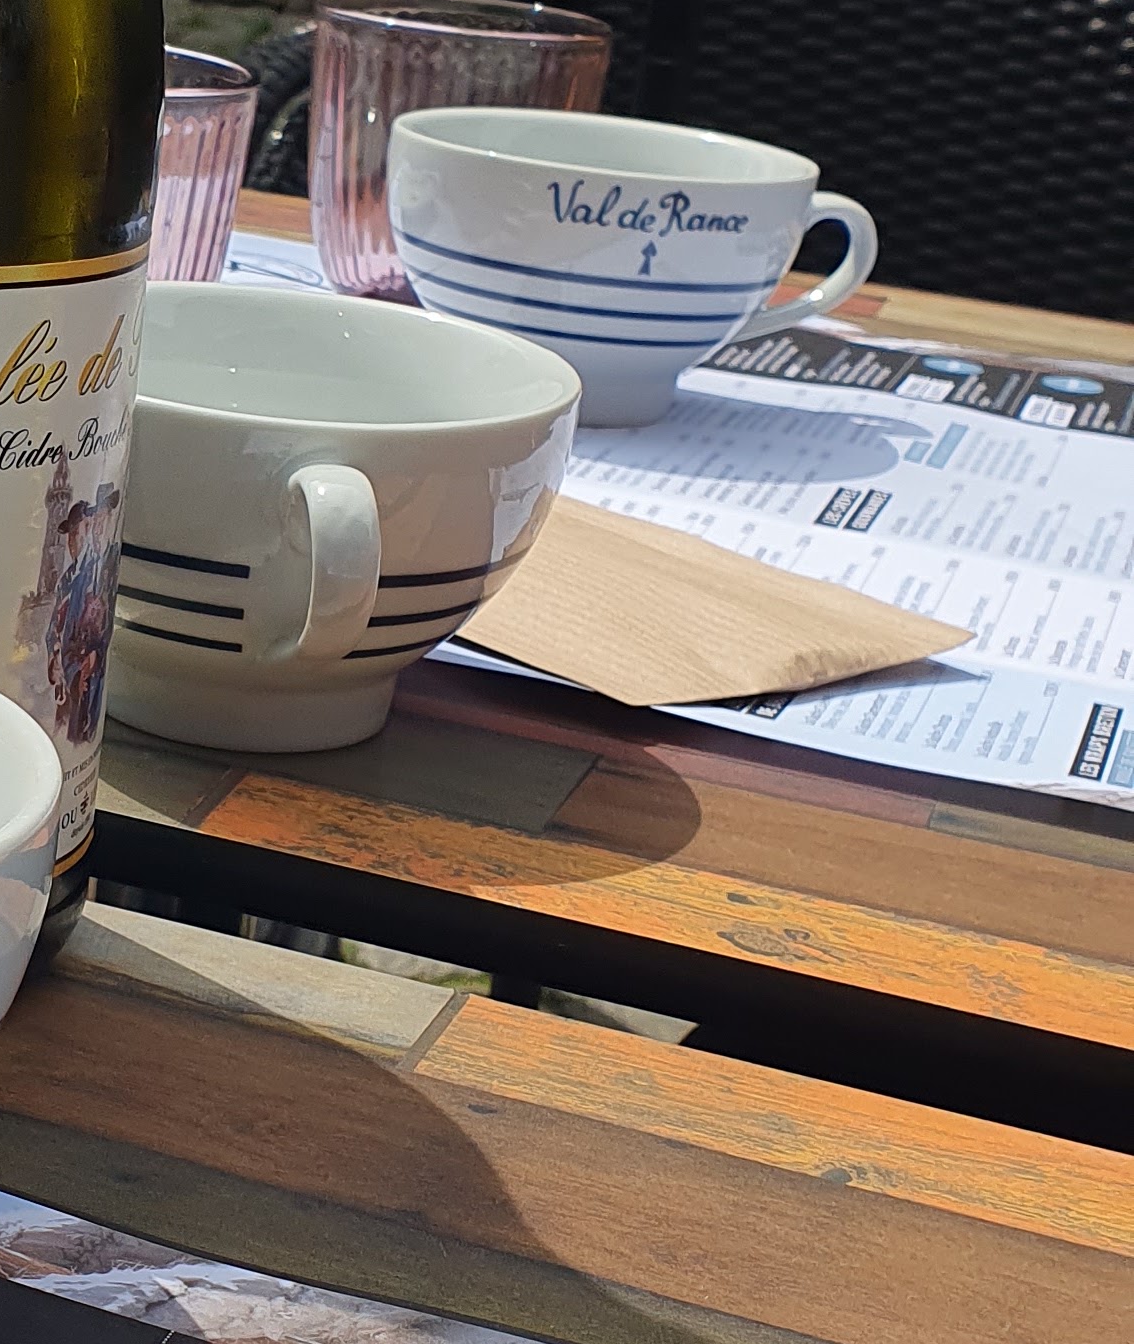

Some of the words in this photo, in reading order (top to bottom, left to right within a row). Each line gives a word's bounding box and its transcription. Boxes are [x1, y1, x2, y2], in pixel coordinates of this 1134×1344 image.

[547, 178, 622, 227] Val
[616, 196, 657, 233] de
[657, 189, 749, 238] Rance
[77, 313, 125, 397] de
